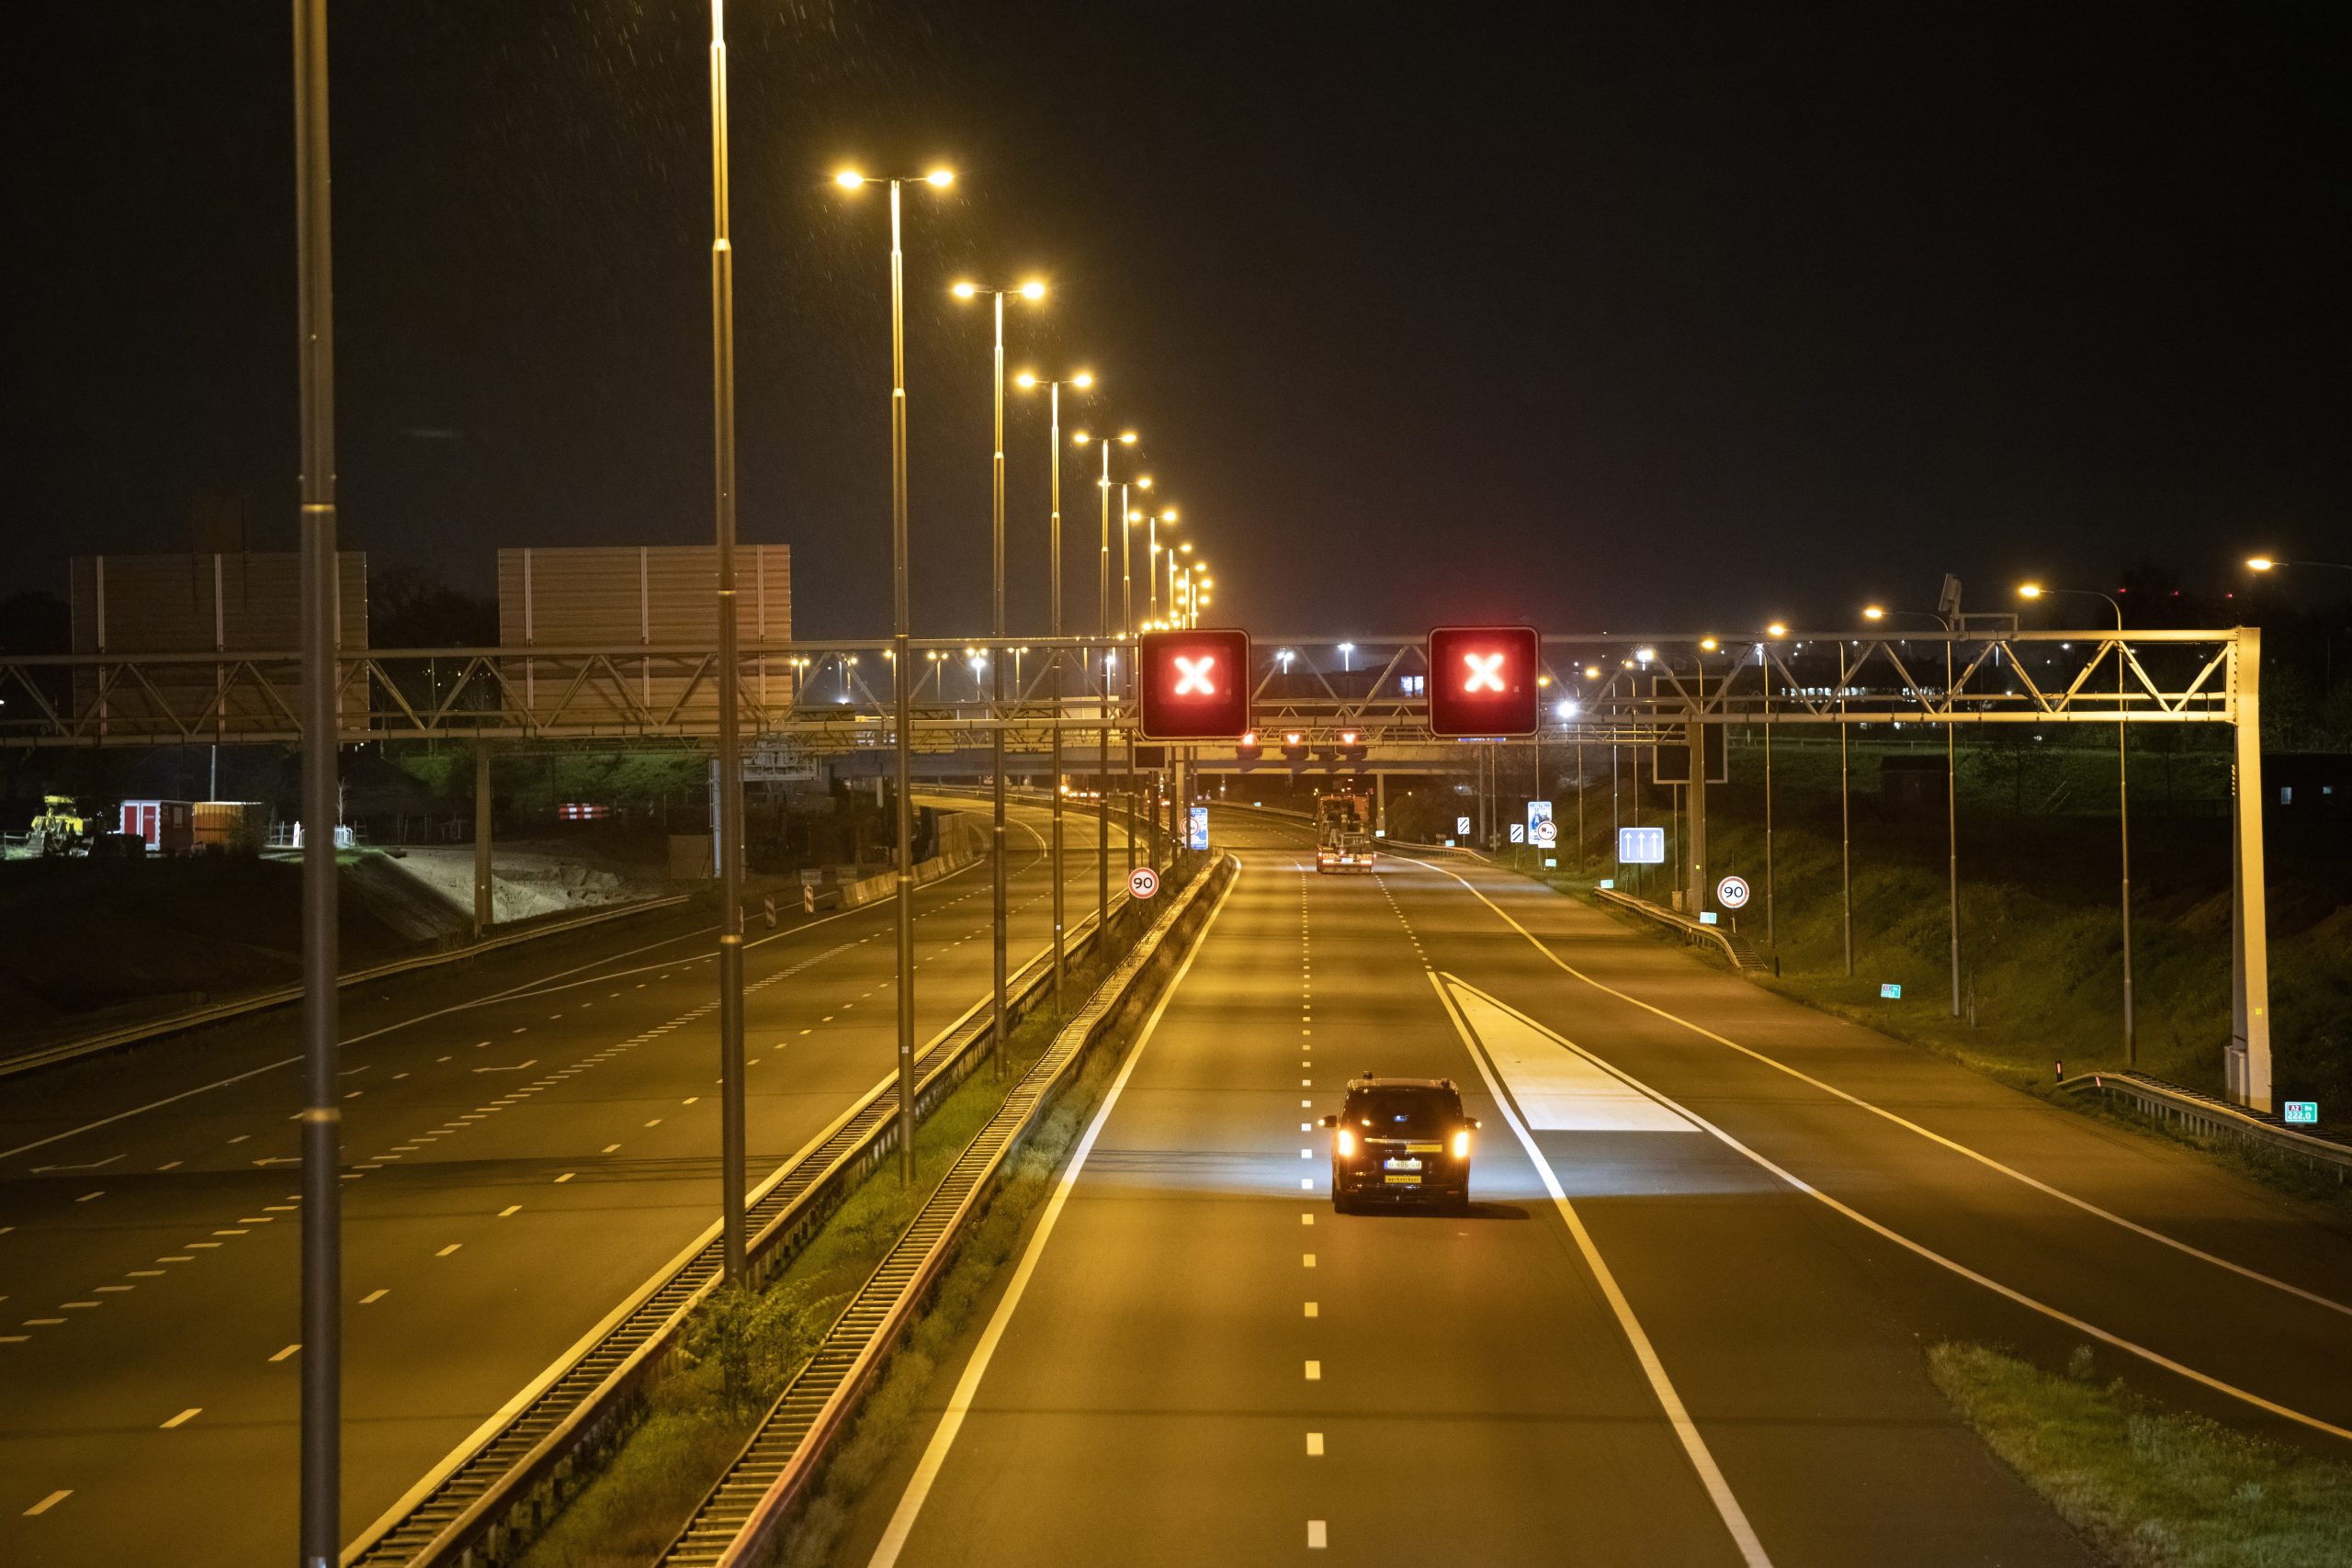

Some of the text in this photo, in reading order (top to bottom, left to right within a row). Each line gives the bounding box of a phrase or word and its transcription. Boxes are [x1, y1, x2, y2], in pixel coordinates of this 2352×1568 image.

[1134, 877, 1153, 889] 90
[1724, 886, 1744, 898] 90
[2287, 1111, 2312, 1121] 222,0
